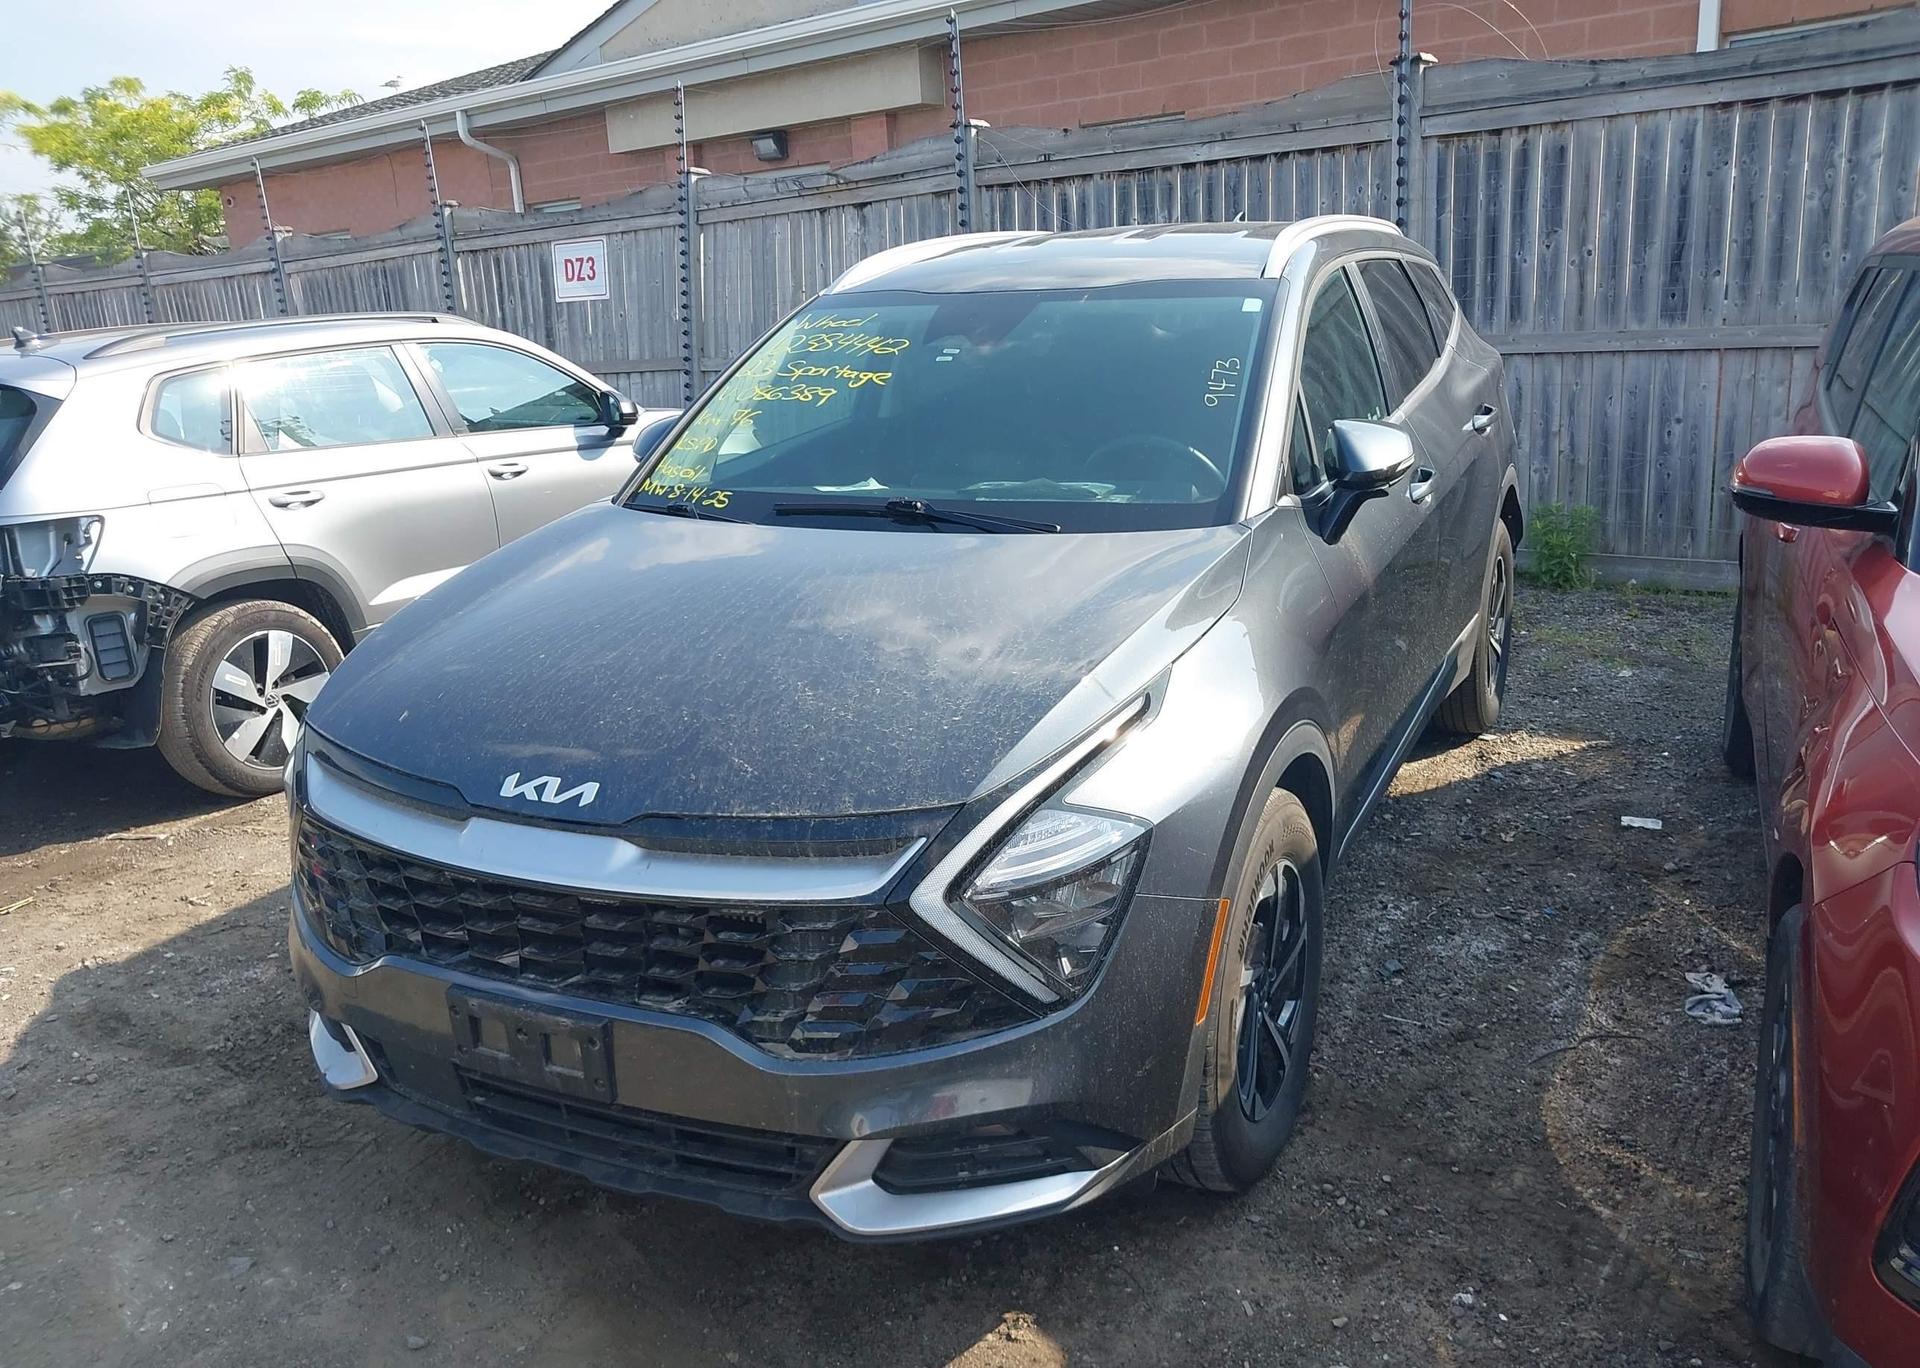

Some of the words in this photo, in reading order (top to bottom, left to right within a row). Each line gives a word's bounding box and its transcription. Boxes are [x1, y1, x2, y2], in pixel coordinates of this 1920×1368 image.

[564, 256, 597, 283] DZ3
[777, 360, 892, 388] Sportage
[1204, 357, 1240, 407] 9473
[499, 771, 600, 808] KIA
